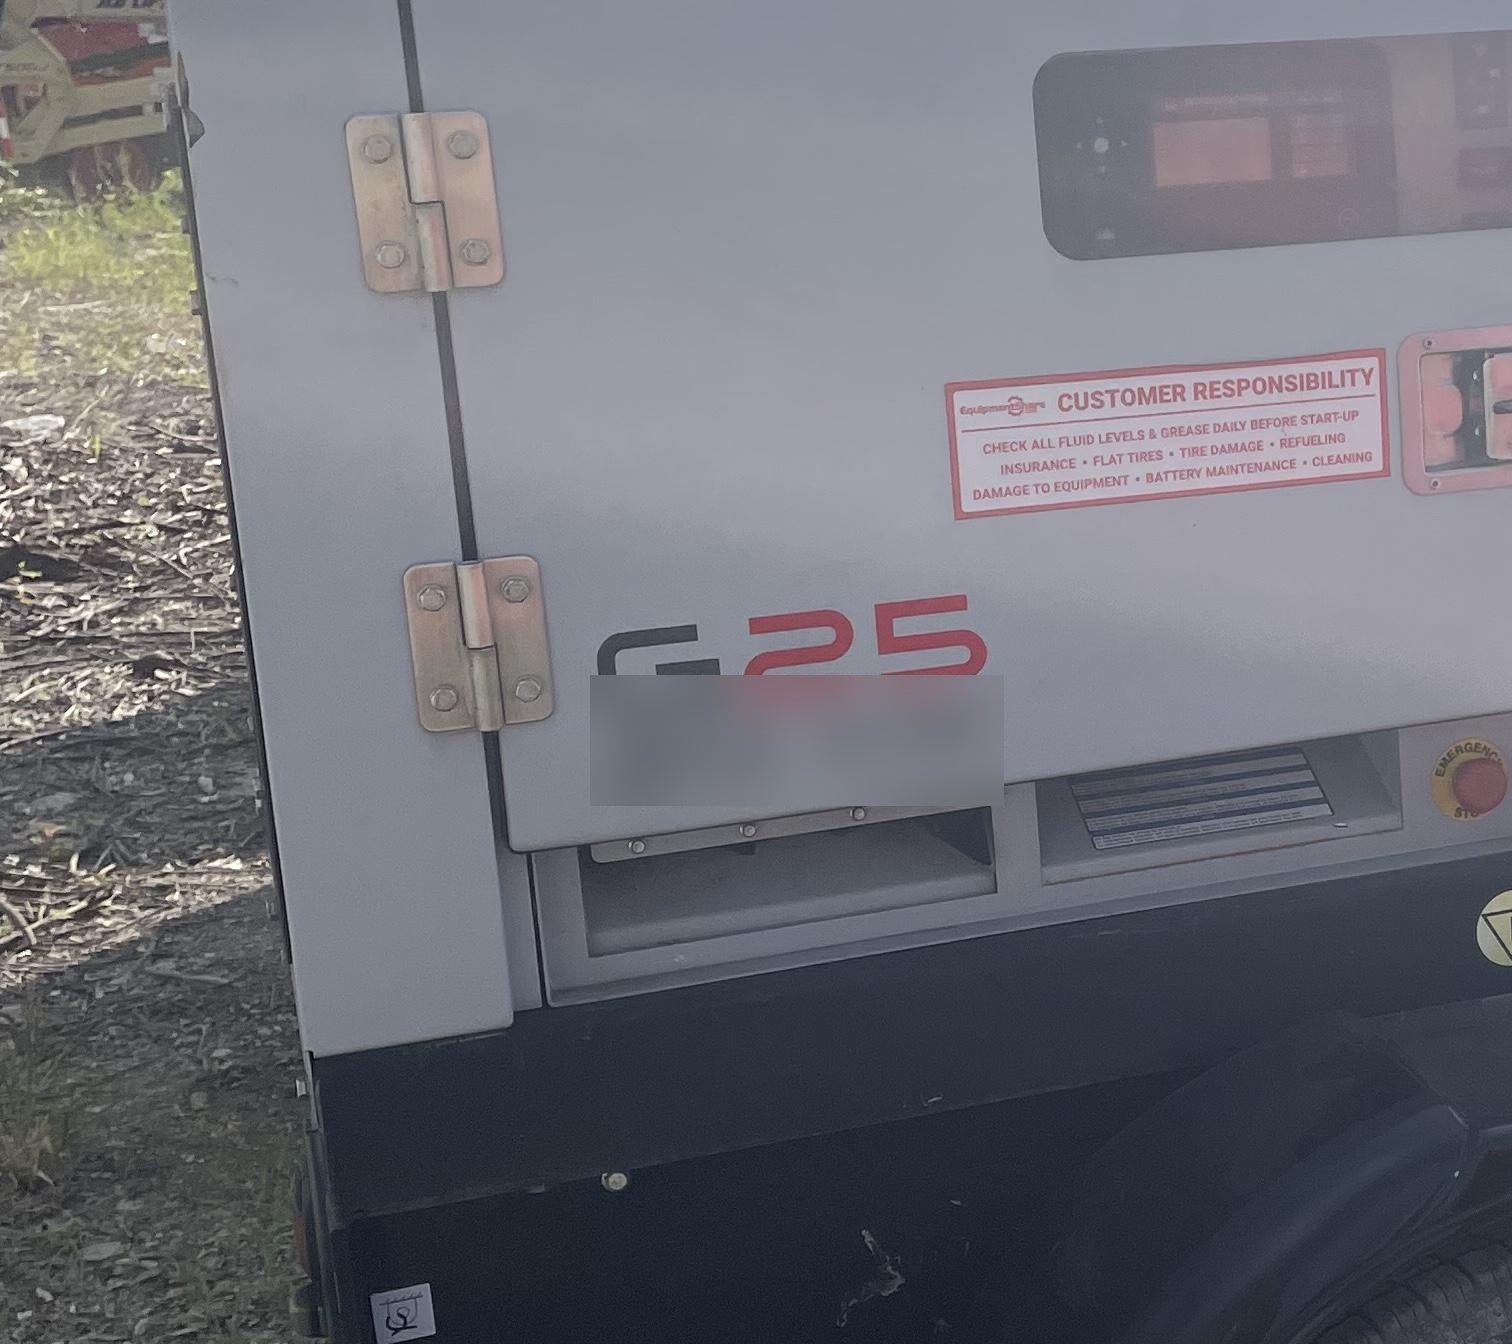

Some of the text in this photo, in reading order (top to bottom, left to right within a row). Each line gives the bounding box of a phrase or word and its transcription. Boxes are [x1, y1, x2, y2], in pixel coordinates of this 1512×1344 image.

[1057, 367, 1375, 413] CUSTOMER RESPONSIBILITY
[983, 410, 1359, 455] CHECK ALL FLUID LEVELS & GREASE DAILY BEFORE START-UP
[1000, 433, 1346, 476] INSURANCE FLAT TIRES TIRE DAMAGE REFUELING
[973, 451, 1373, 500] DAMAGE TO EQUIPMENT BATTERY MAINTENANCE CLEANING
[1454, 806, 1480, 819] STO
